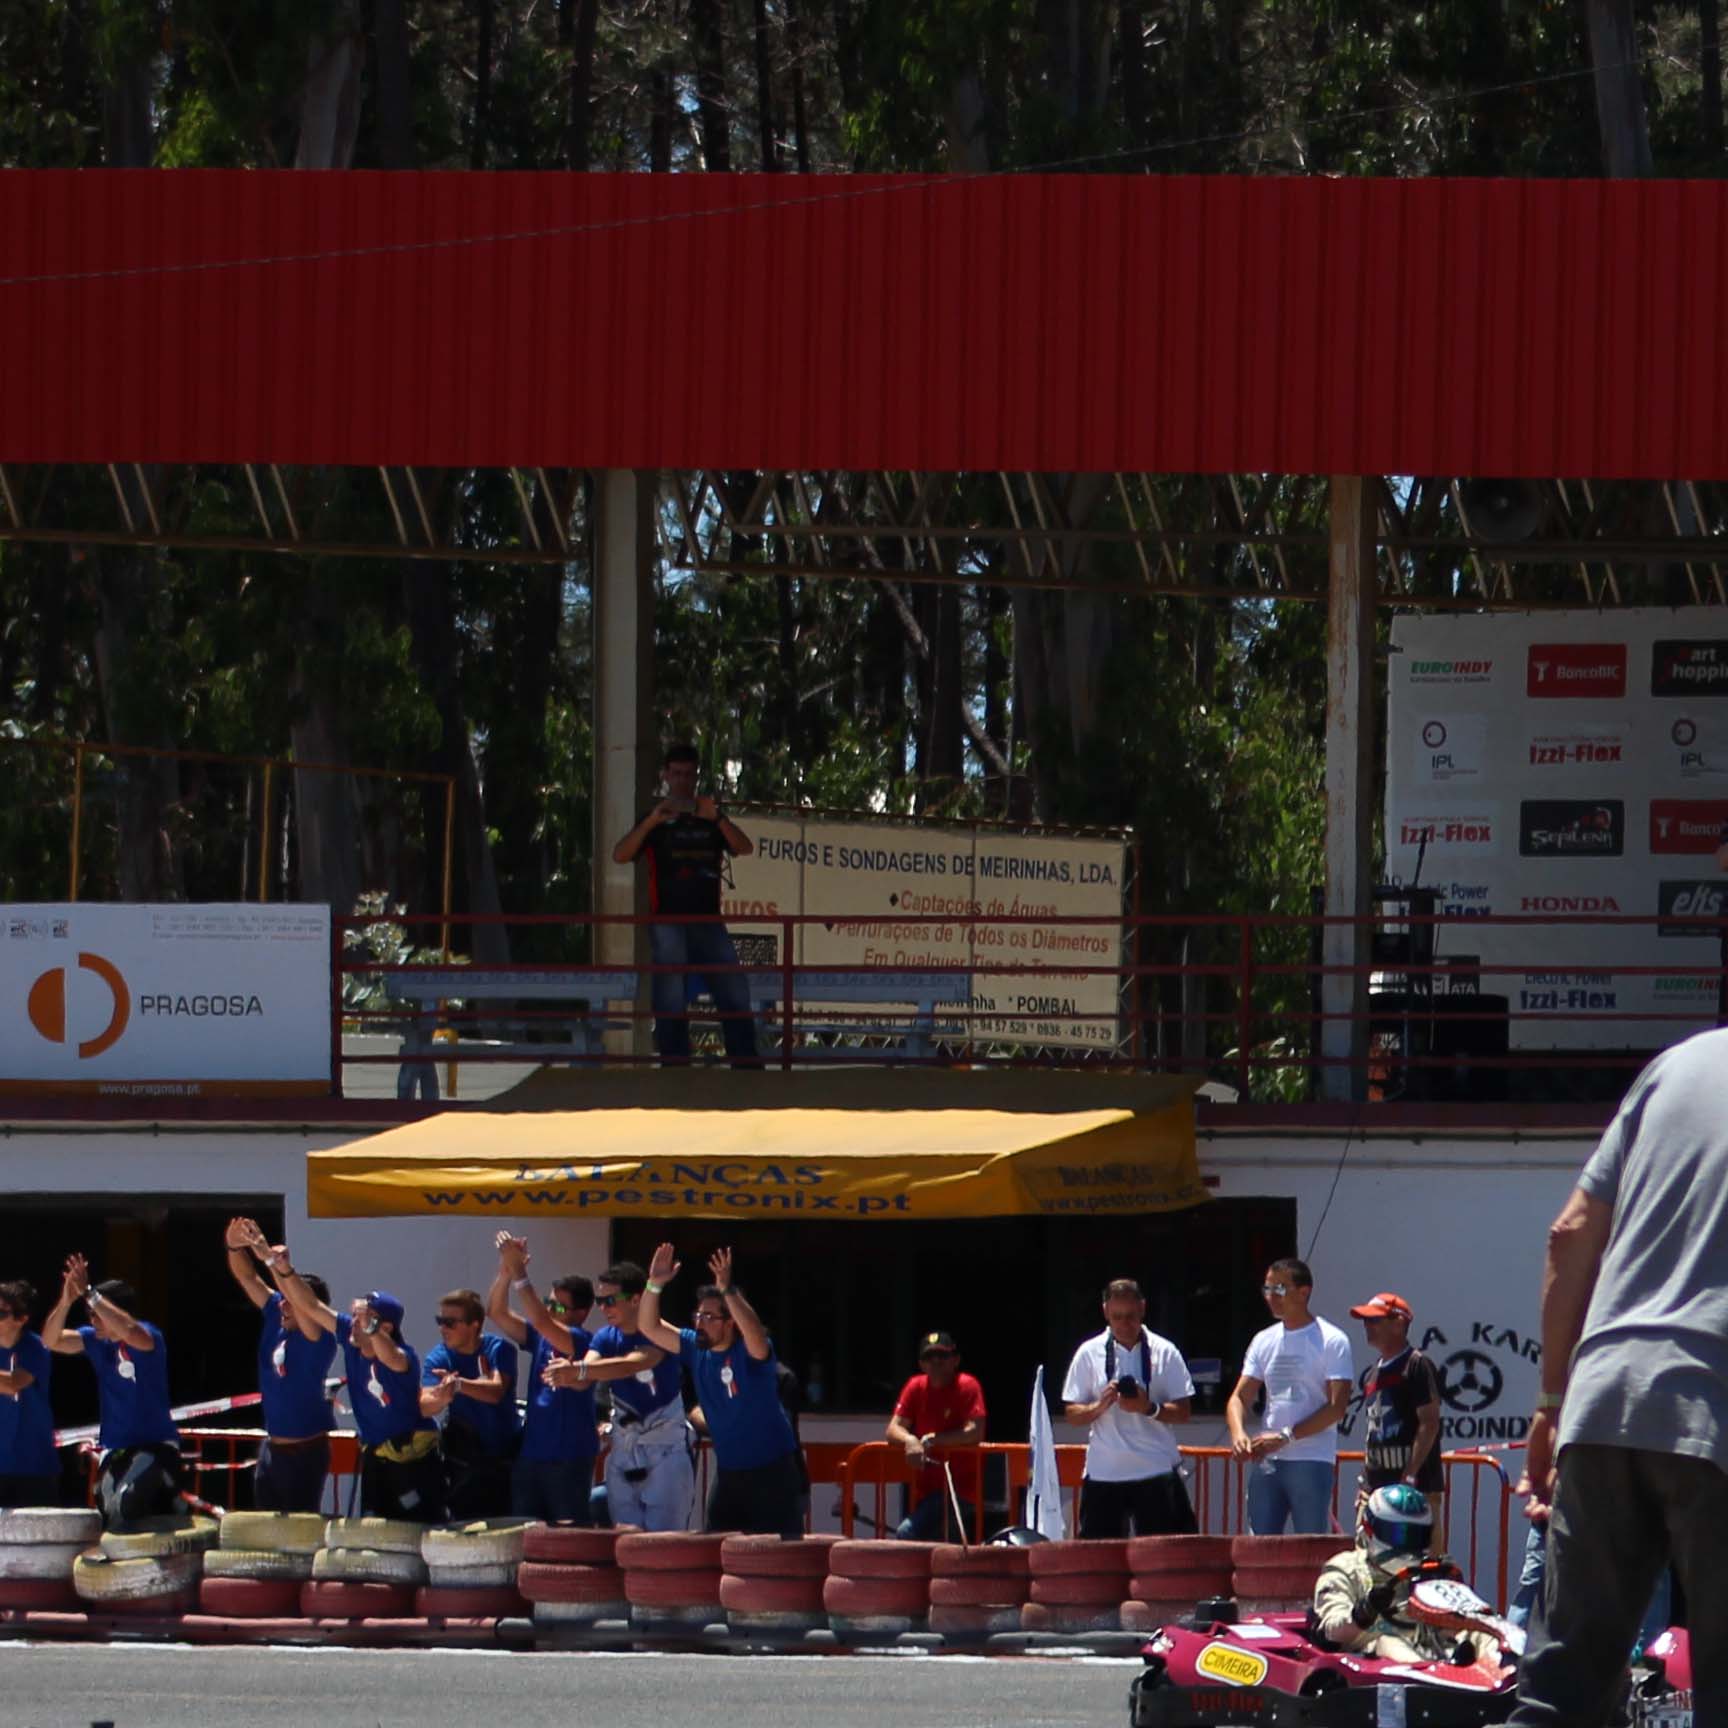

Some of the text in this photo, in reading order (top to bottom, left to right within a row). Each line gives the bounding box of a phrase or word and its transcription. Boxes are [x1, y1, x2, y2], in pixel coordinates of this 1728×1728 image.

[1690, 648, 1717, 661] art
[1410, 661, 1493, 674] EUROINDY
[1678, 820, 1721, 838] Banco
[758, 838, 1118, 887] FUROS E SONDAGENS DE MEIRINHAS, LDA.
[1450, 883, 1489, 899] Power
[719, 898, 778, 916] uros
[900, 890, 980, 916] Captações
[982, 890, 1005, 916] de
[1520, 896, 1621, 912] HONDA
[934, 923, 953, 943] de
[957, 924, 1005, 947] Todos
[1008, 931, 1028, 947] os
[1031, 924, 1110, 953] Diâmetros
[864, 948, 888, 967] Em
[893, 950, 965, 968] Qualquer
[1654, 977, 1721, 991] EUROIN
[140, 994, 264, 1017] PRAGOSA
[1016, 995, 1079, 1016] POMBAL
[513, 1161, 826, 1187] BALANÇAS
[423, 1186, 913, 1213] www.pestronix.pt
[1440, 1415, 1535, 1439] ROIND
[1203, 1650, 1259, 1681] CIMEIRA
